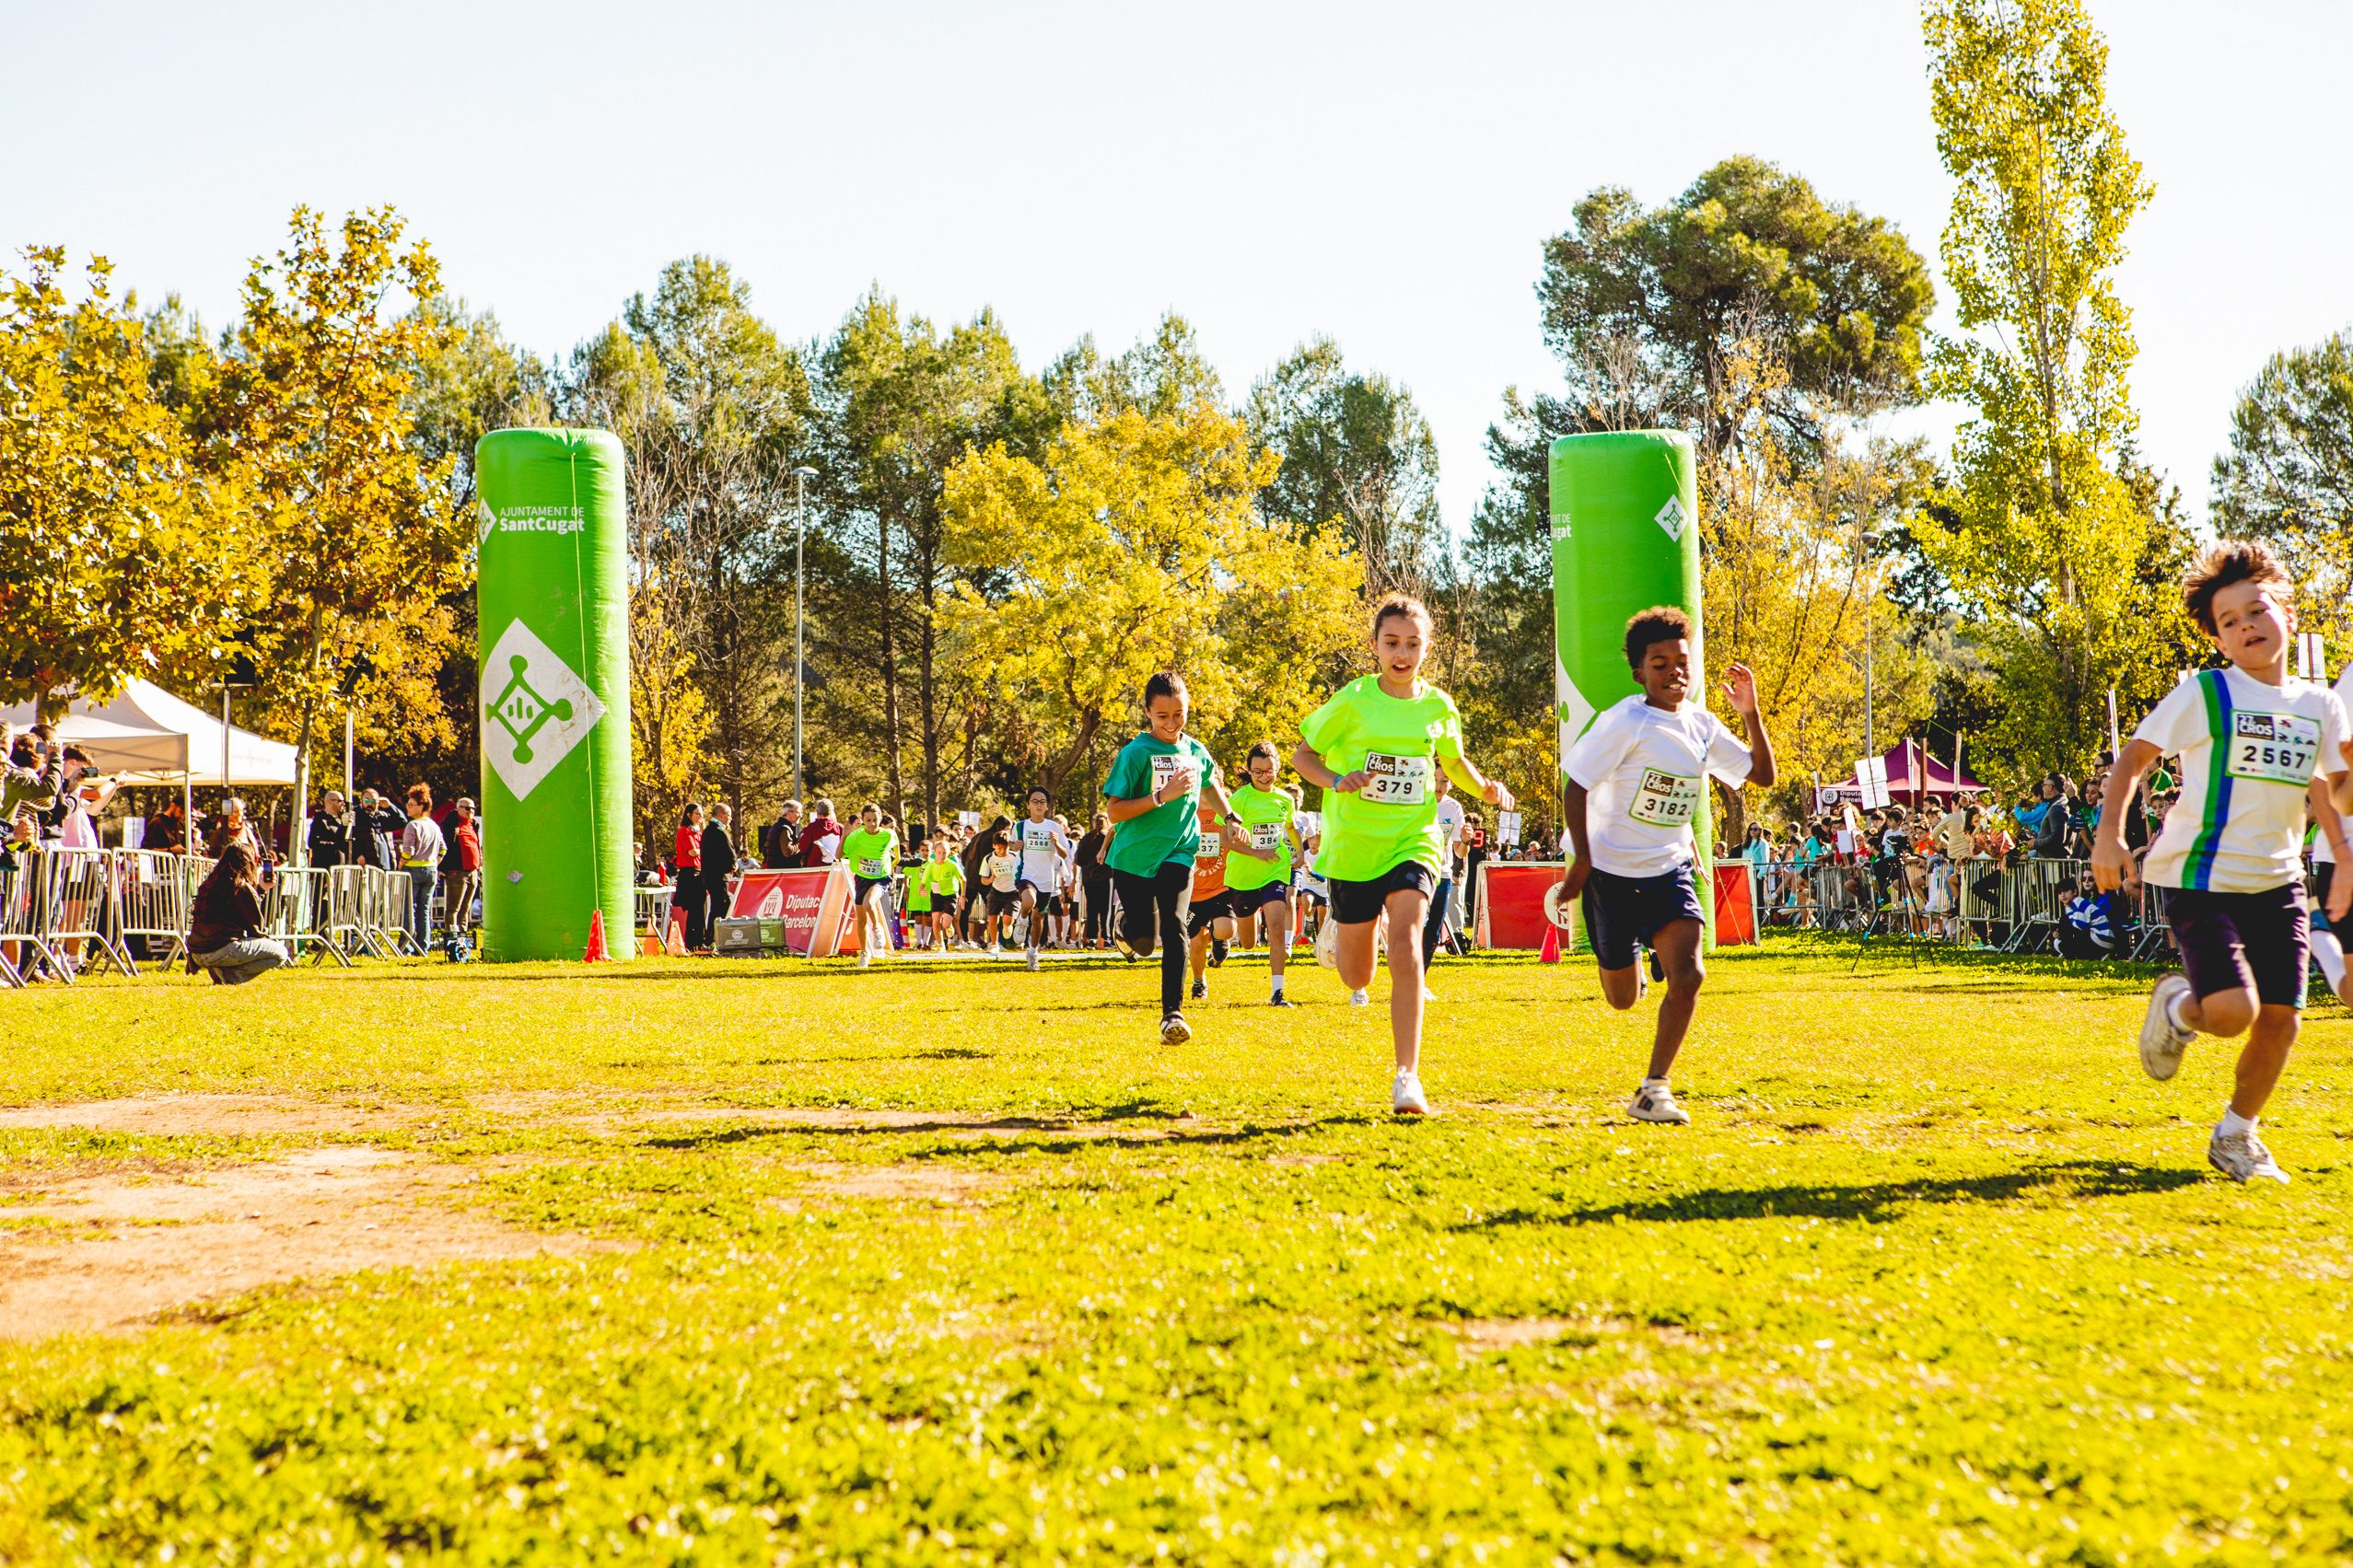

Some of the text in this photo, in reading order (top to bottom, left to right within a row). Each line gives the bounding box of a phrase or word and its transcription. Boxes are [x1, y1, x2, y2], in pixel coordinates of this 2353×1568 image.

[500, 506, 585, 517] AJUNTAMENT DE
[500, 517, 585, 534] SantCugat
[2239, 724, 2273, 736] CROS
[2242, 745, 2306, 769] 2567
[1369, 761, 1394, 772] CROS
[1376, 779, 1413, 795] 379
[1647, 781, 1672, 793] CROS
[1644, 798, 1687, 816] 3182
